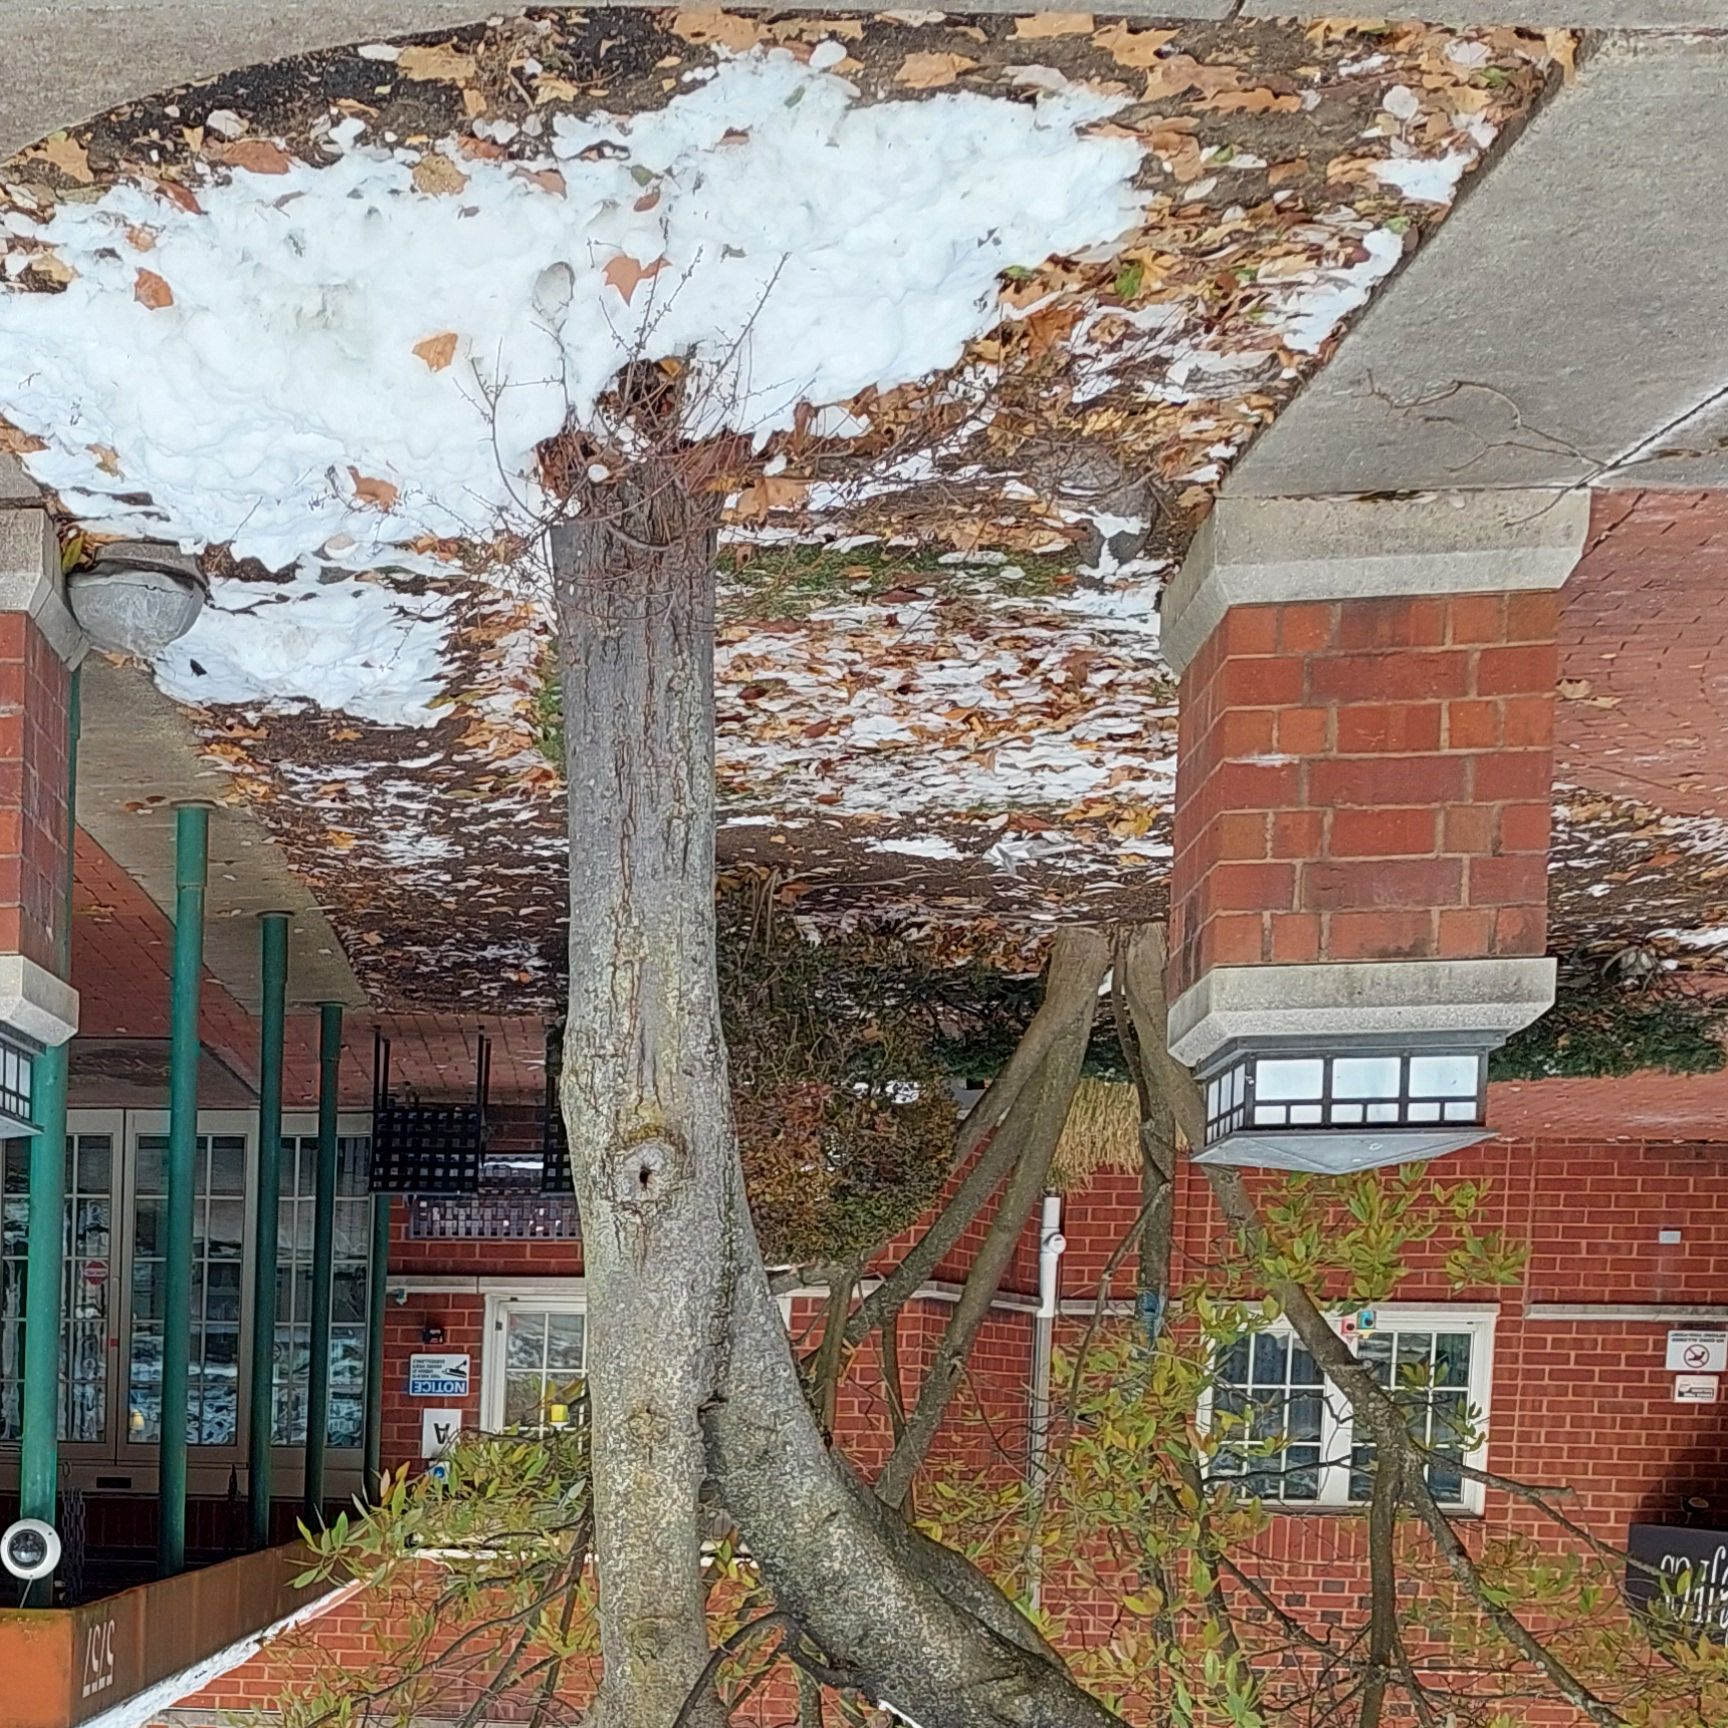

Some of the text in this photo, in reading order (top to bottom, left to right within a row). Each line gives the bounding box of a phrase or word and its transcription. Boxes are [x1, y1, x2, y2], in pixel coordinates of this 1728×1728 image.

[413, 1380, 466, 1393] NOTICE
[433, 1422, 451, 1445] A
[81, 1619, 116, 1699] 5757
